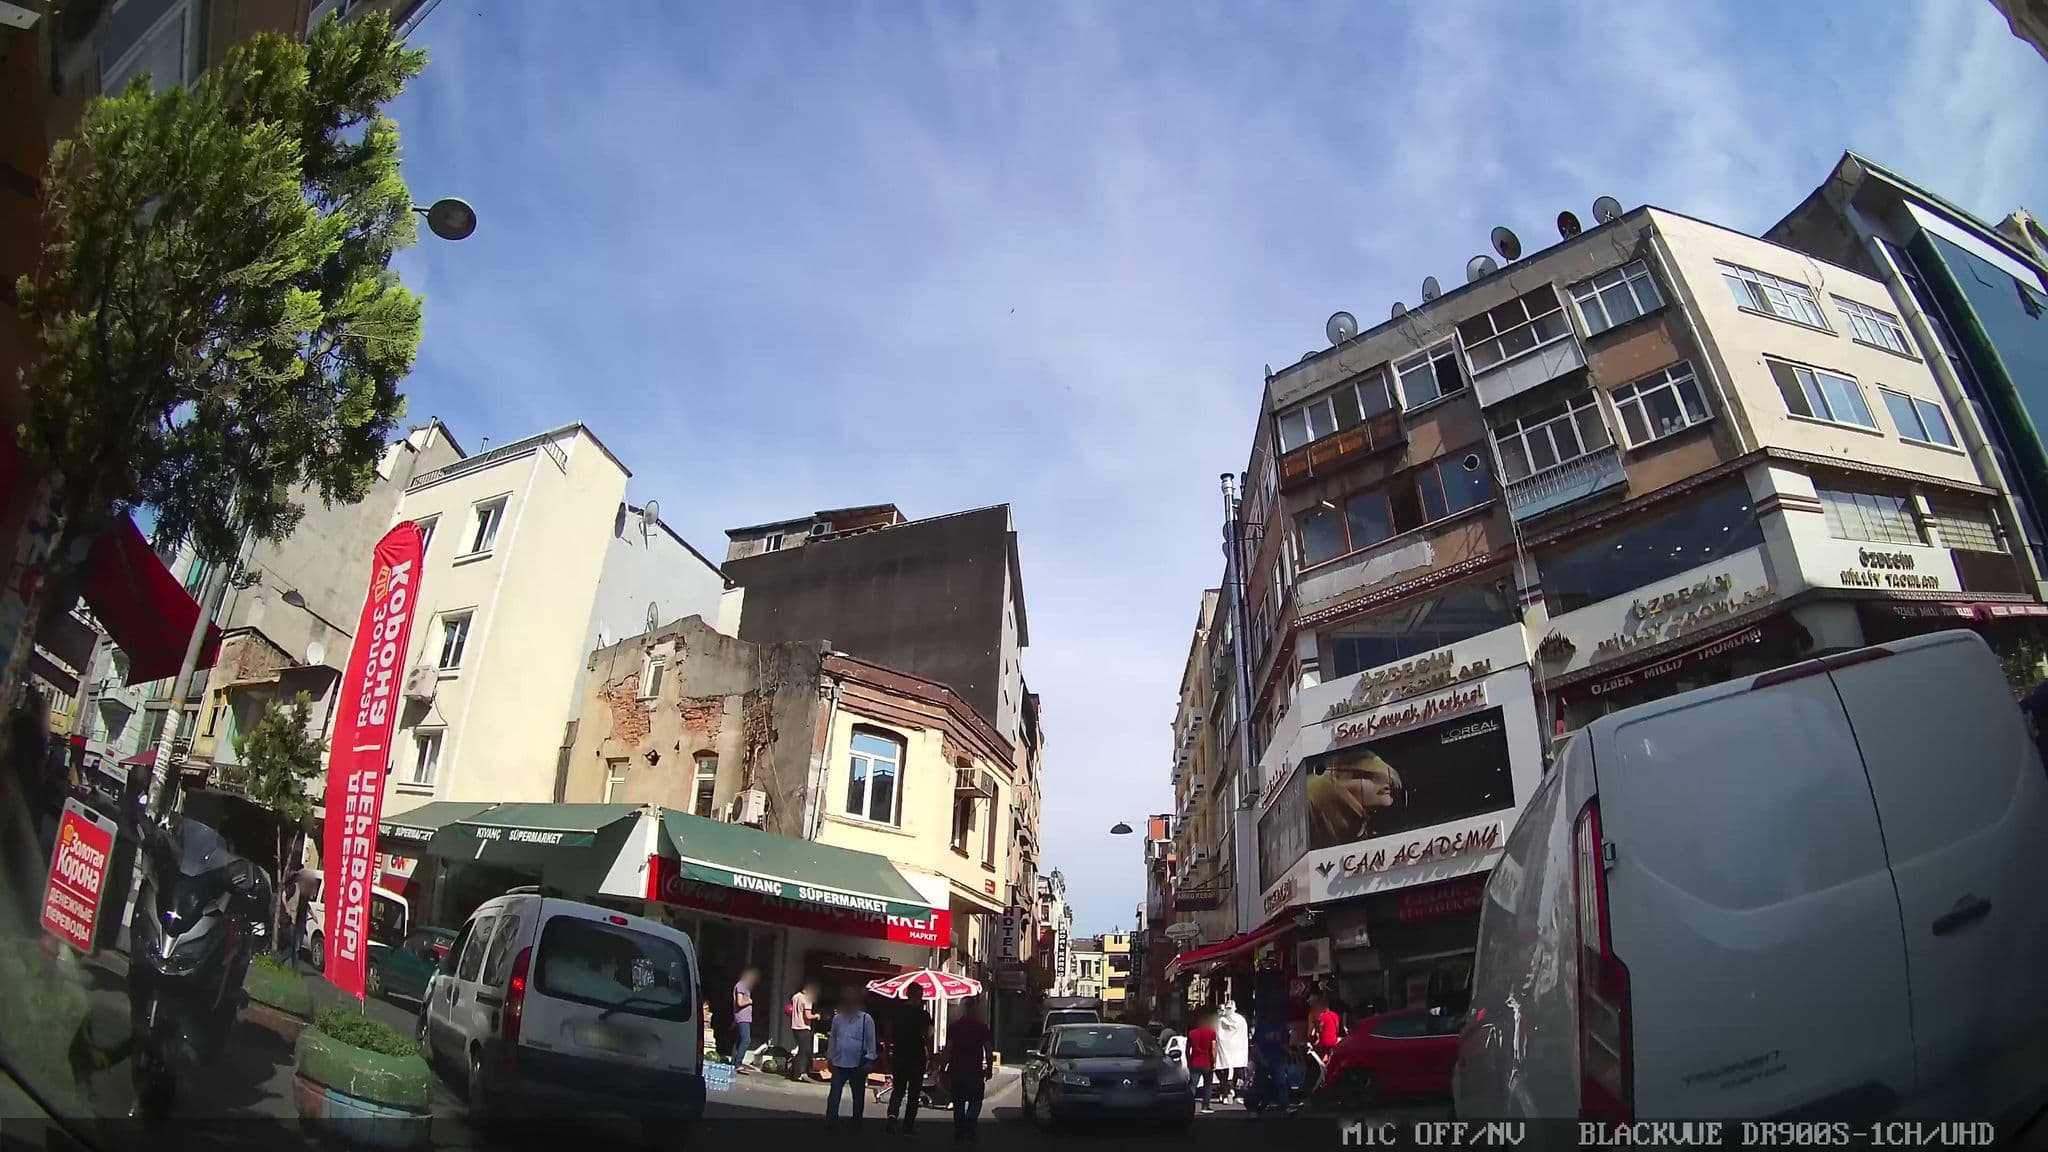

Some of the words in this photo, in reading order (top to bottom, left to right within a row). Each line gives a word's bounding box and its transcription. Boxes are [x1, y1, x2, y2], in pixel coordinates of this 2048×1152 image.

[509, 829, 564, 845] SÜPERMARKET
[1343, 849, 1386, 873] CAN
[1392, 823, 1499, 866] ACADEMY
[56, 844, 101, 894] Корона
[733, 873, 782, 897] KIVANÇ
[799, 886, 888, 913] SÜPERMARKET
